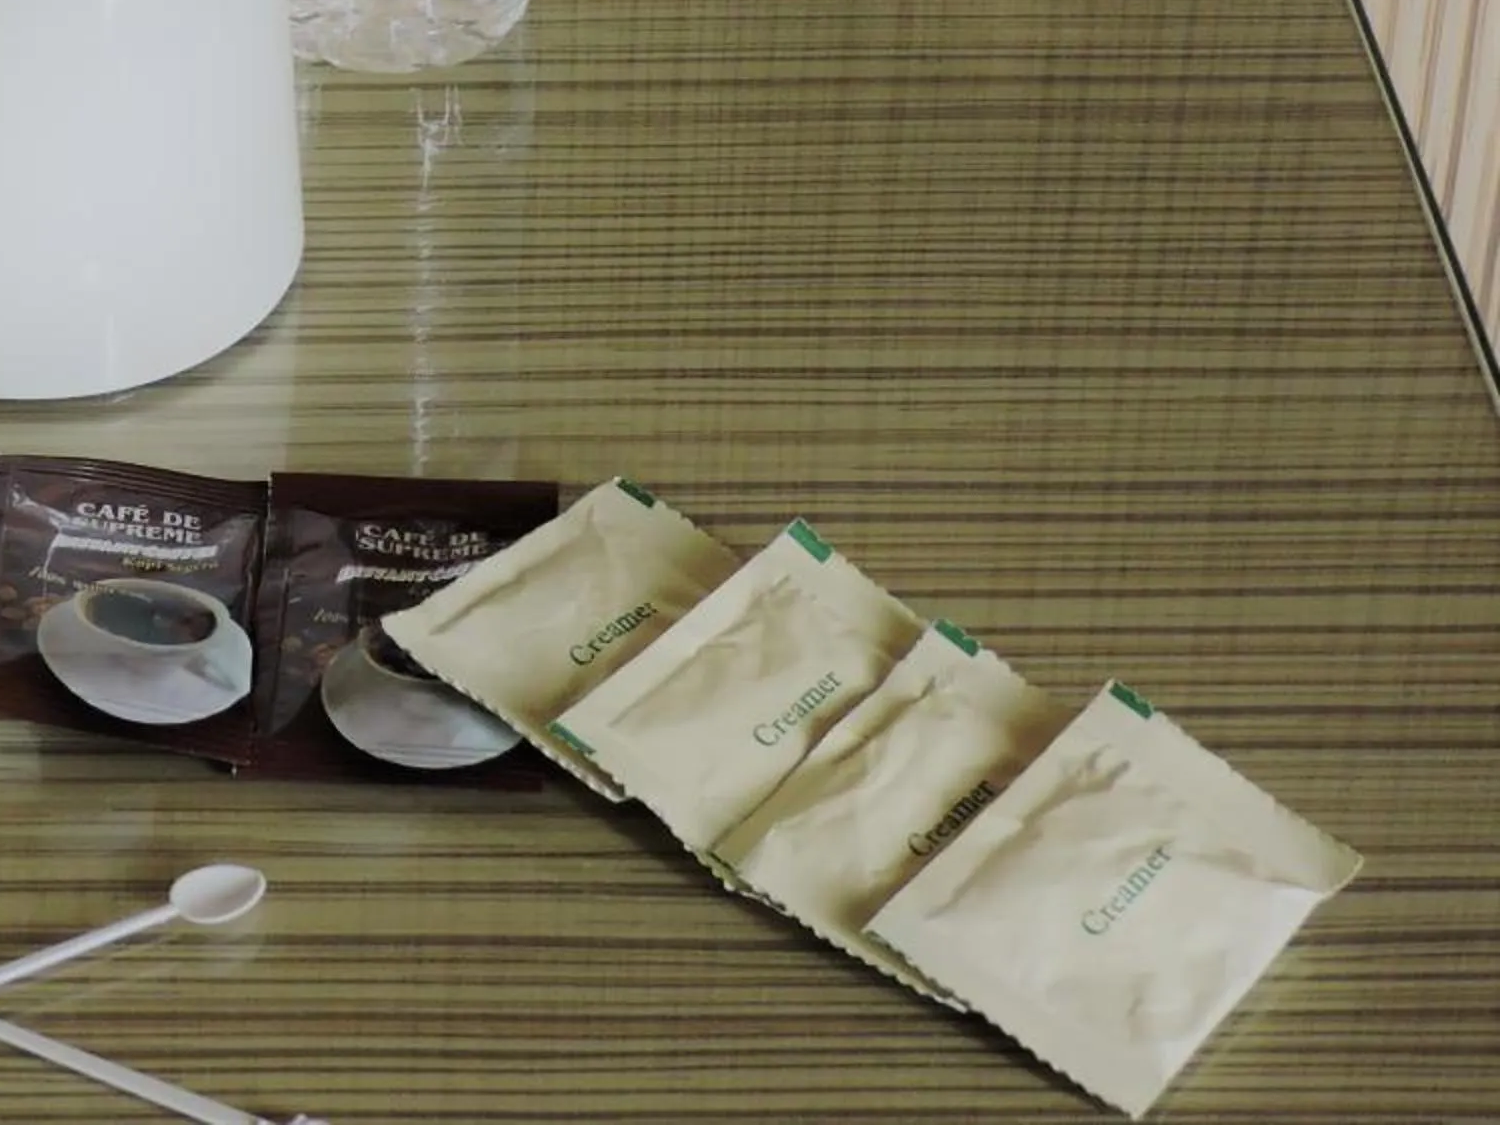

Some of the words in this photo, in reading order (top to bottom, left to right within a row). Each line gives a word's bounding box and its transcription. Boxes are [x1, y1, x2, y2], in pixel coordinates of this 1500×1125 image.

[162, 509, 202, 531] DE
[357, 536, 488, 561] SUPREME
[450, 530, 487, 546] DE
[569, 601, 659, 667] Creamer
[752, 671, 844, 747] Creamer
[907, 778, 996, 857] Creamer
[1080, 844, 1173, 936] Creamer
